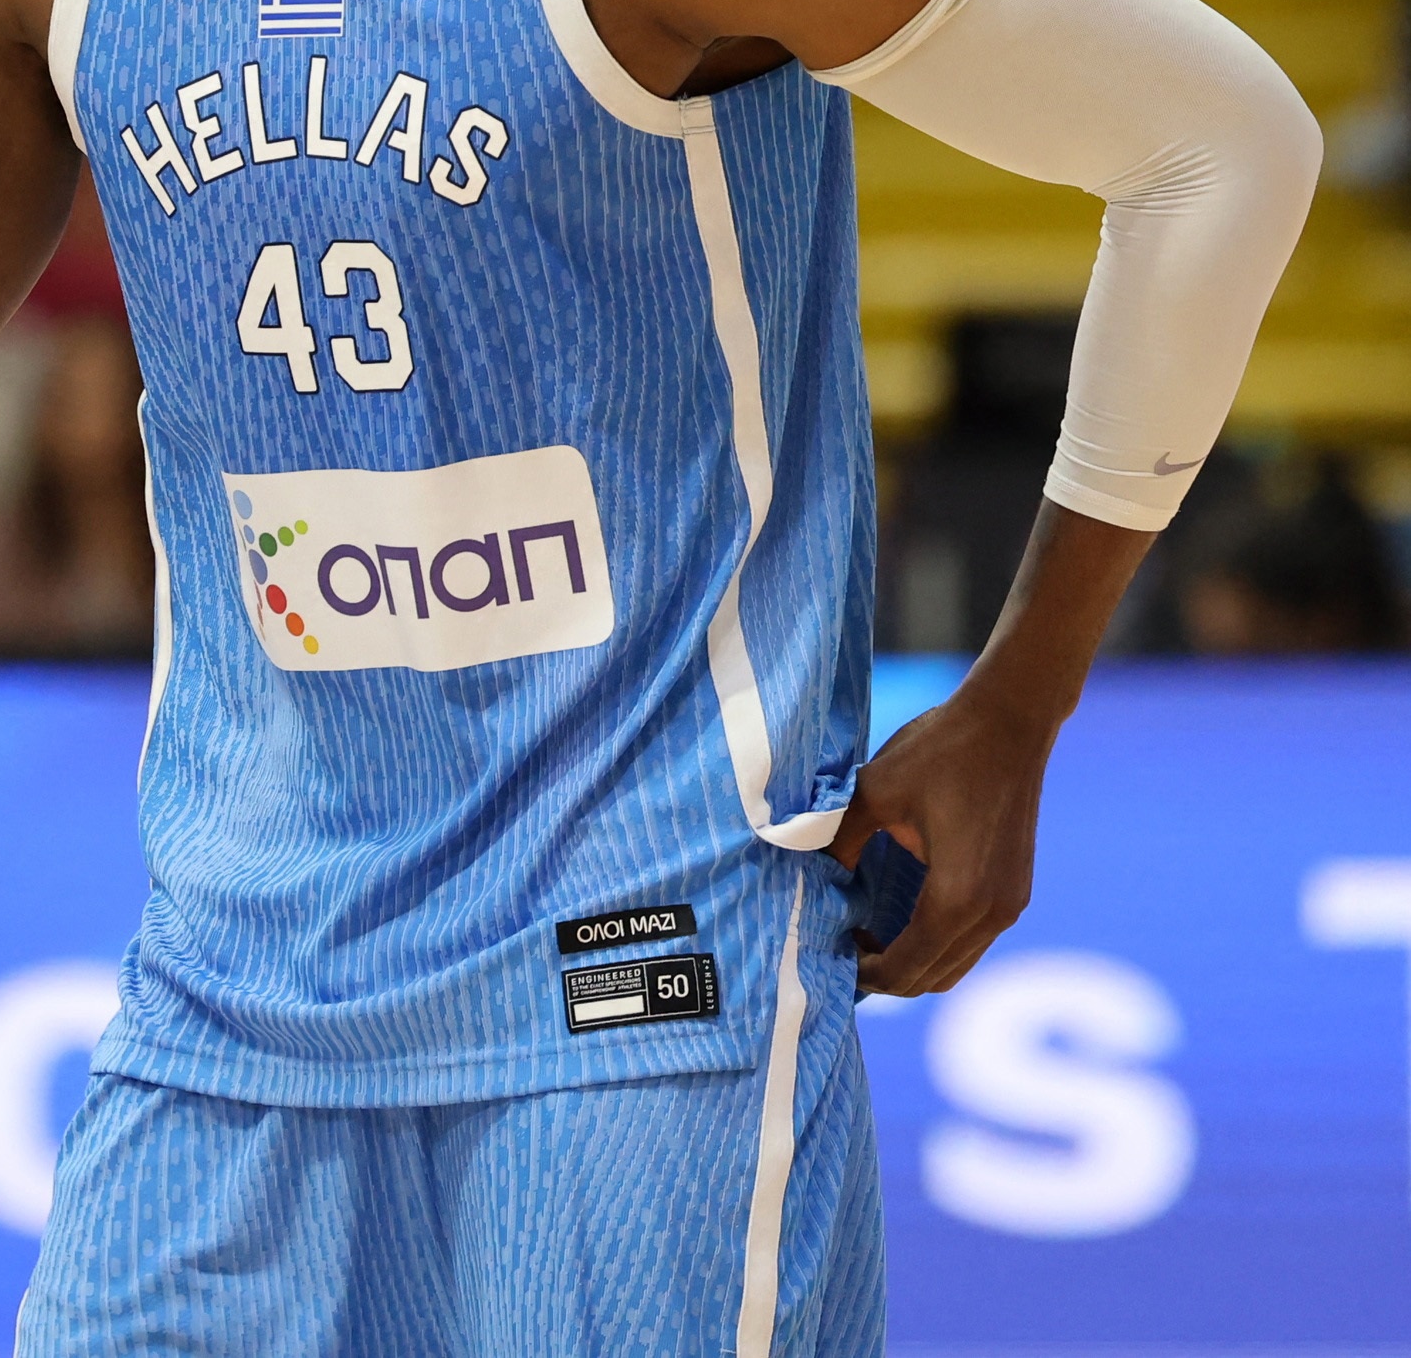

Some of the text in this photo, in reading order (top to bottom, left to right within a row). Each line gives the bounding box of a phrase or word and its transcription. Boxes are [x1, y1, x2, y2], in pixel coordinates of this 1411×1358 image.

[119, 55, 510, 217] HELLAS
[236, 239, 415, 394] 43
[571, 968, 642, 986] ENGINEERED
[657, 974, 689, 999] 50
